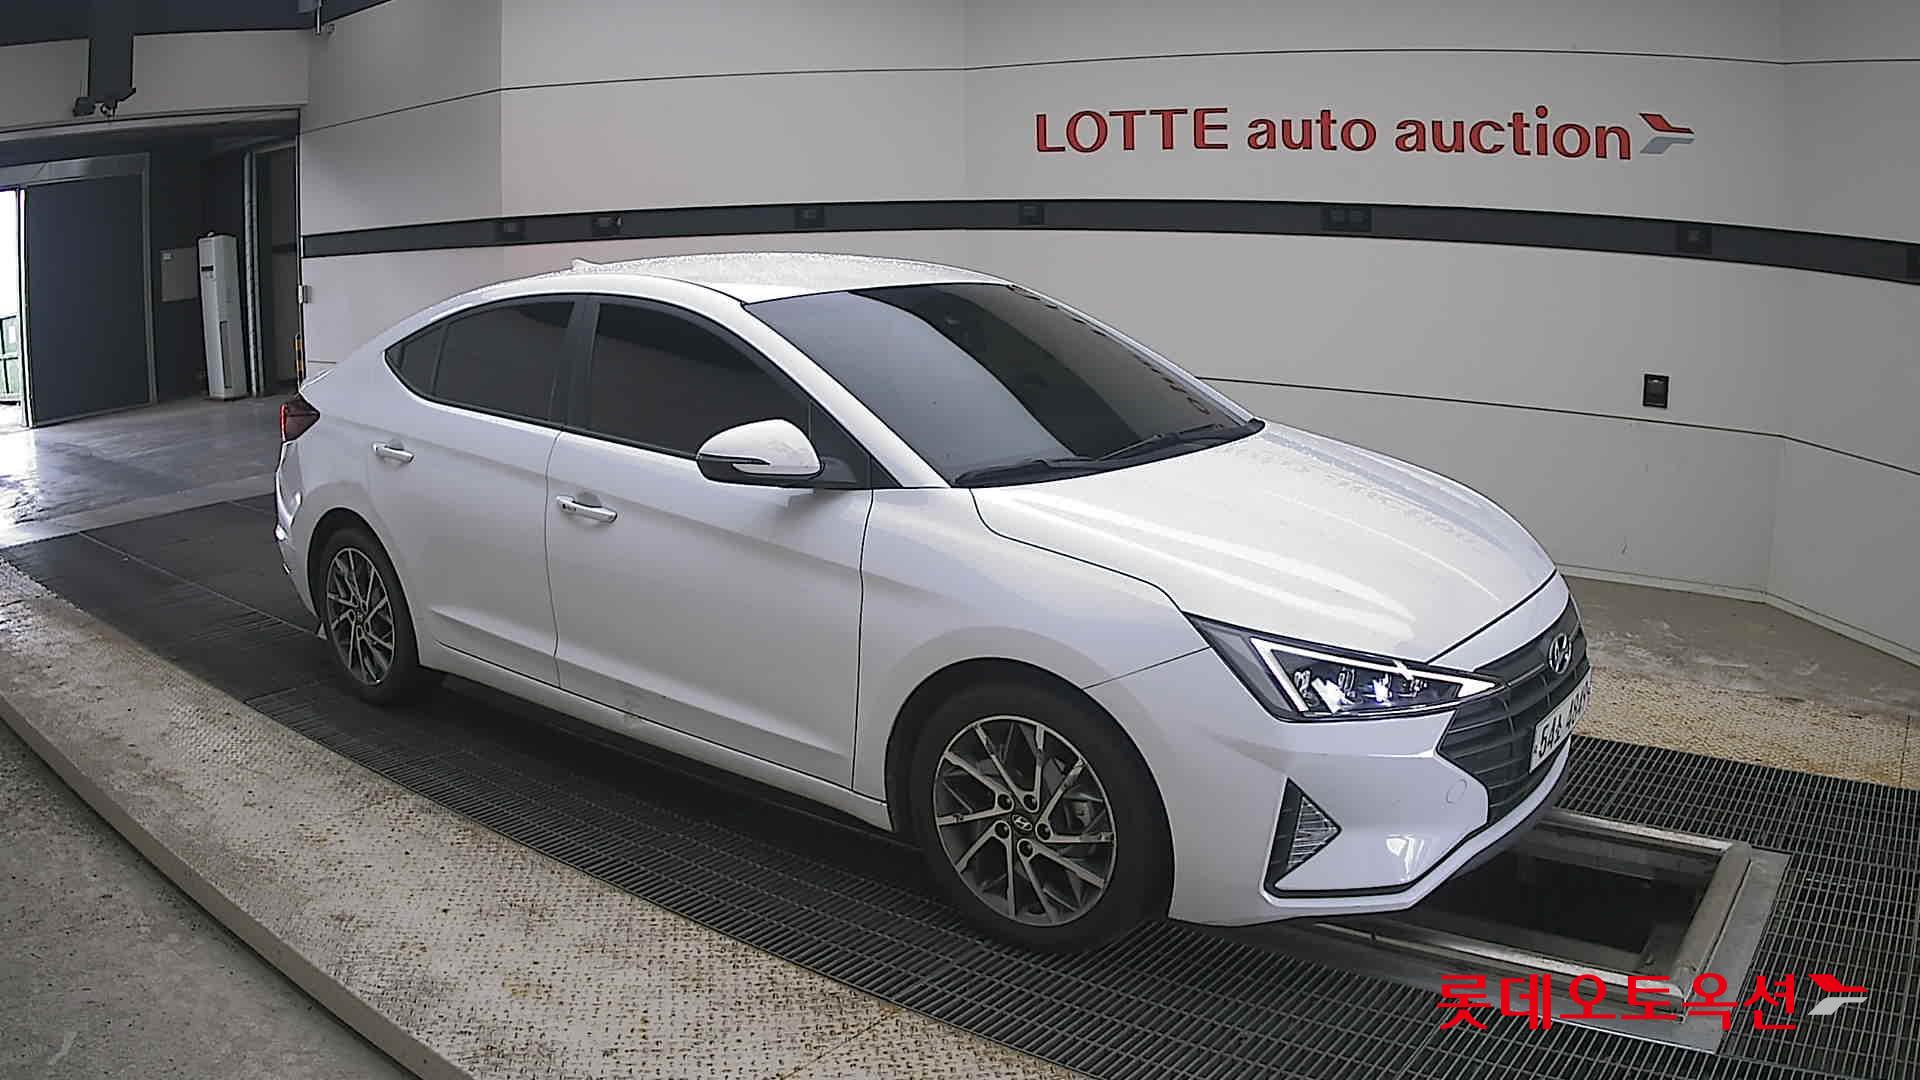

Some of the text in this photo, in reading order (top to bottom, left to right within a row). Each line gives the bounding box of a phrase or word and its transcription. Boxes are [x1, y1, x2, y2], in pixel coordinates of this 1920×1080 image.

[1035, 106, 1632, 160] LOTTE auto auction
